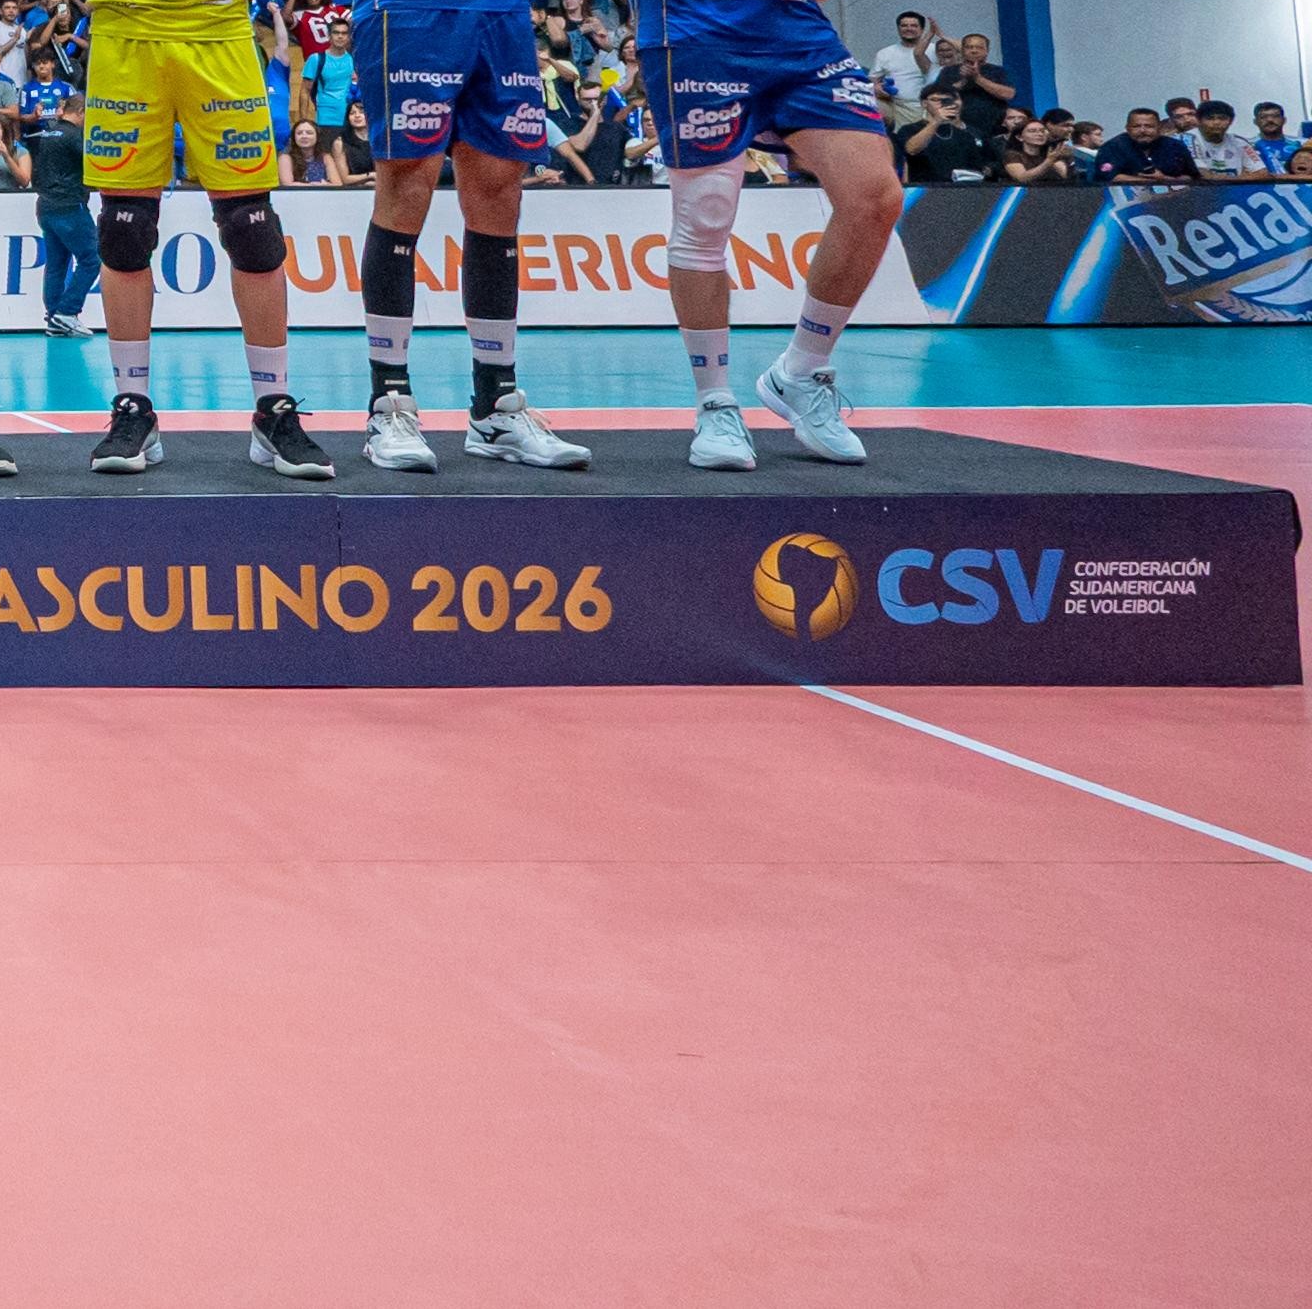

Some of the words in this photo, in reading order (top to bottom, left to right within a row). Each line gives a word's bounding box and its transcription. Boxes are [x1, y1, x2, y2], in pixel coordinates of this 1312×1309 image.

[389, 69, 463, 88] ultragaz
[673, 78, 750, 96] ultragaz
[87, 97, 148, 115] ultragaz
[201, 96, 268, 113] ultragaz
[516, 103, 546, 120] Goo
[688, 102, 742, 124] Good
[392, 113, 441, 131] Bom
[502, 115, 542, 135] Bom
[679, 121, 731, 140] Bom
[90, 126, 140, 144] Good
[222, 126, 271, 145] Good
[86, 141, 122, 158] Bom
[216, 144, 262, 160] Bom
[1074, 557, 1211, 576] CONFEDERACIÓN
[877, 547, 1065, 625] CSV
[1068, 579, 1197, 596] SUDAMERICANA
[411, 564, 613, 633] 2026
[1064, 598, 1087, 614] DE
[1090, 598, 1171, 615] VOLEIBOL
